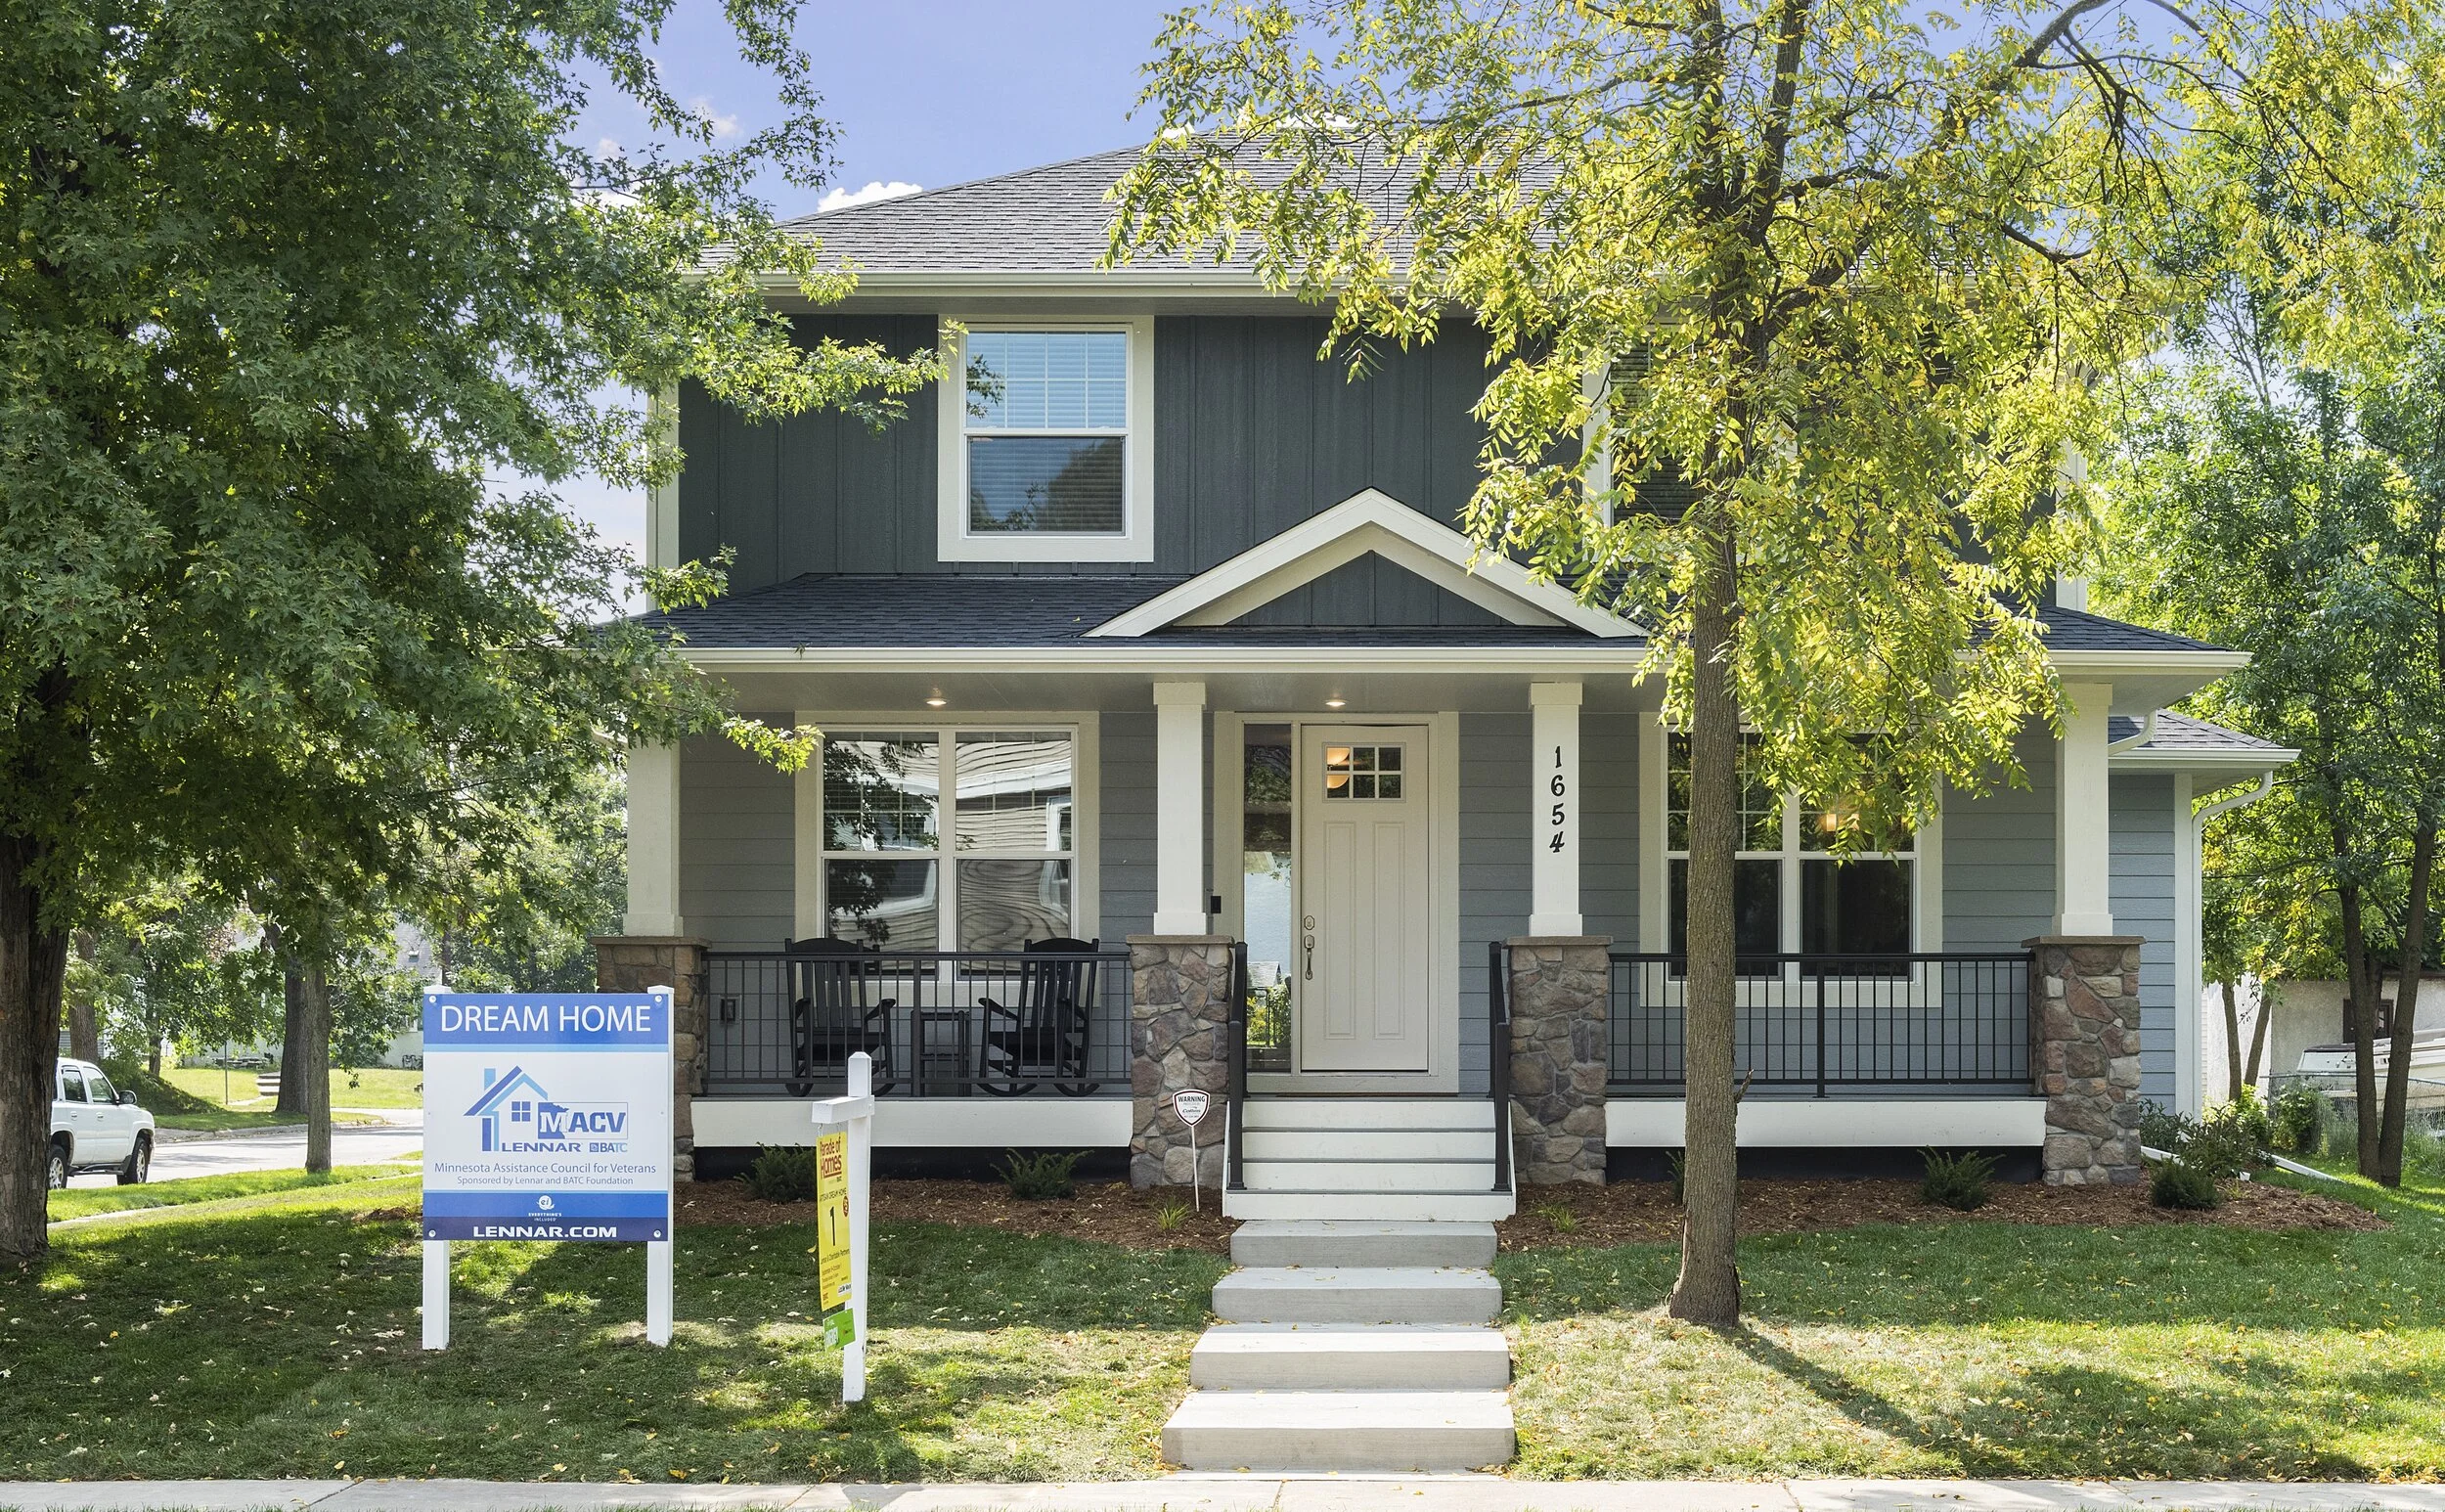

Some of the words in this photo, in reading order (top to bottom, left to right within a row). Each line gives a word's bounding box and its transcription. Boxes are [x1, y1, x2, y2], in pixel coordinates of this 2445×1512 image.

[1549, 745, 1565, 853] 1654
[441, 1005, 549, 1032] DREAM
[559, 1005, 651, 1032] HOME
[539, 1111, 626, 1133] MACV
[501, 1142, 582, 1152] LENNAR
[600, 1142, 628, 1152] BATC
[820, 1137, 835, 1157] Parade
[434, 1162, 490, 1174] Minnesota
[493, 1162, 549, 1174] Assistance
[551, 1162, 591, 1174] Council
[593, 1162, 608, 1174] for
[609, 1162, 657, 1174] Veterans
[820, 1154, 842, 1180] Homes
[457, 1176, 501, 1185] Sponsored
[503, 1176, 514, 1185] by
[515, 1176, 544, 1184] Lennar
[545, 1176, 561, 1184] and
[563, 1176, 584, 1184] BATC
[586, 1176, 634, 1184] Foundation
[473, 1225, 617, 1238] LENNAR.COM
[829, 1205, 836, 1247] 1
